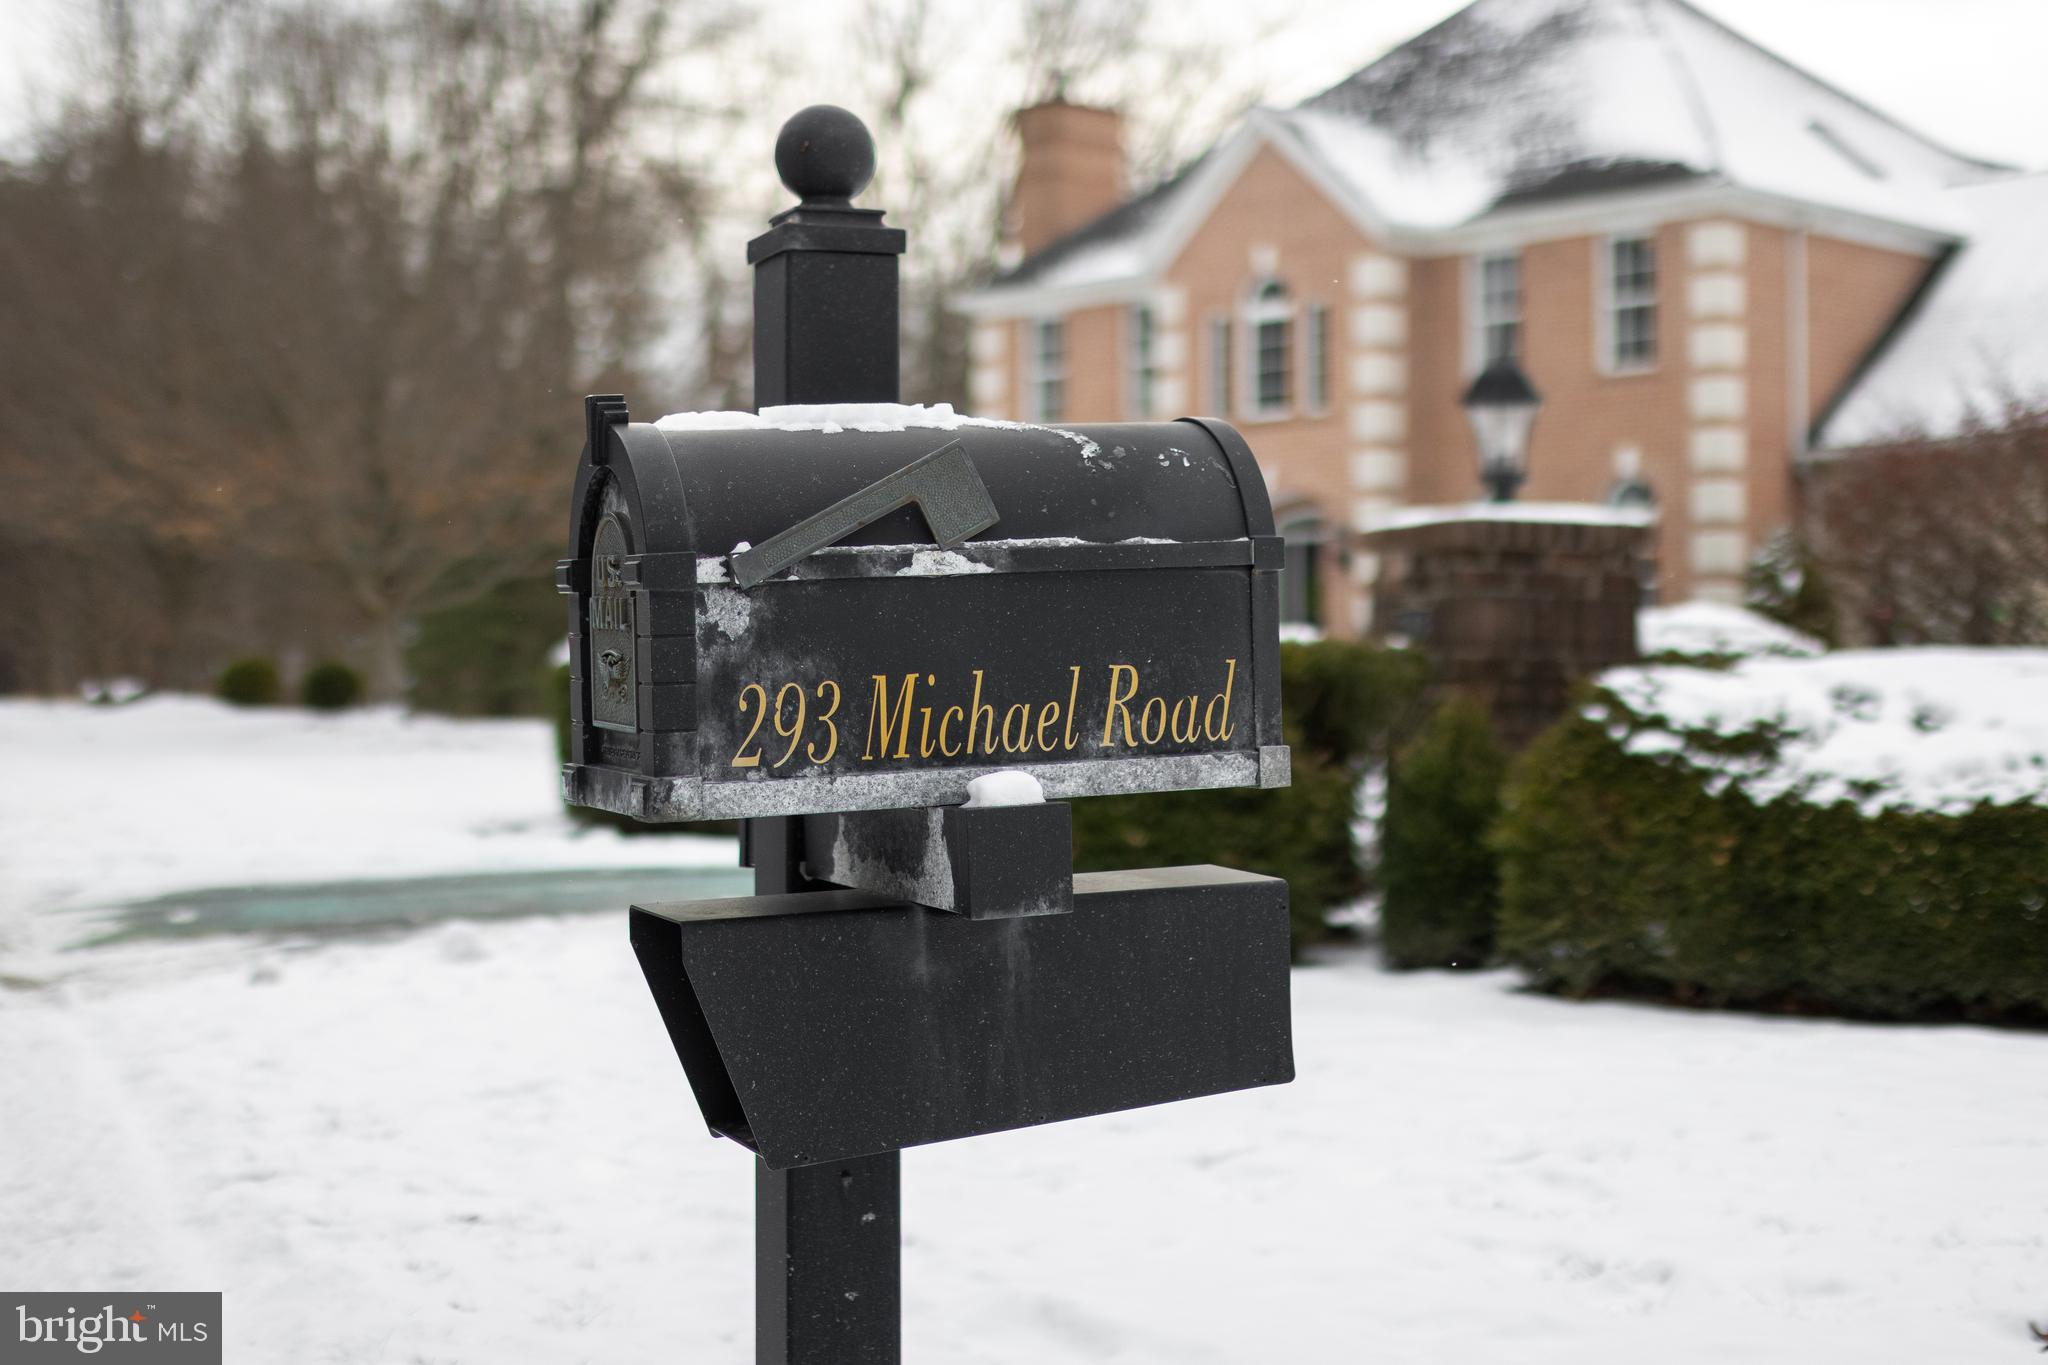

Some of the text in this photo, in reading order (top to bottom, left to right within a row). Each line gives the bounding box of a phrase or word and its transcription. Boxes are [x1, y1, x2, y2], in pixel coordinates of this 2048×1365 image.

[590, 597, 629, 631] MAIL
[731, 658, 1237, 768] 293 Michael Road
